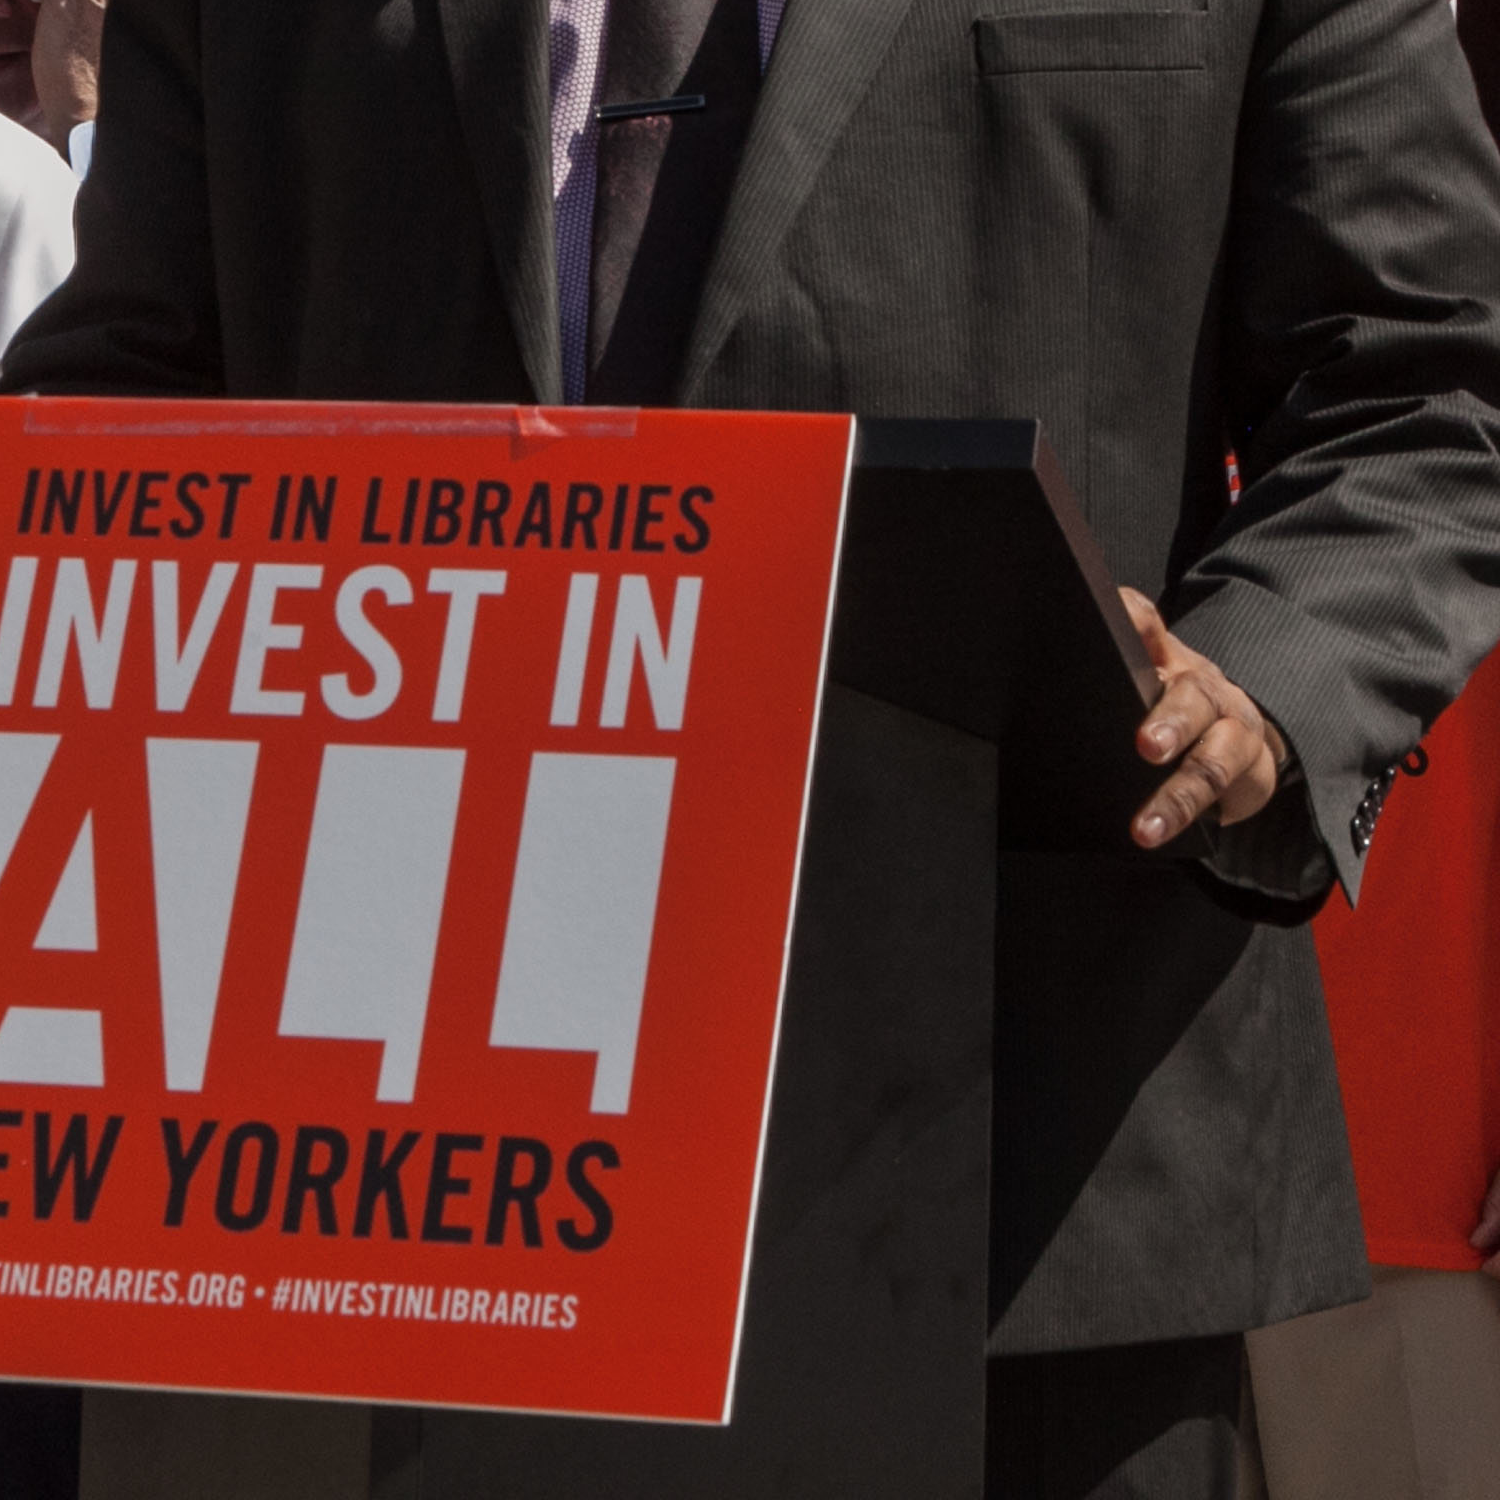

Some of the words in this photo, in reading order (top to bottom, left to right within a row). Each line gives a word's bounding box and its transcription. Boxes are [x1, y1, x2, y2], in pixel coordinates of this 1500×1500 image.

[17, 469, 250, 538] INVEST
[270, 475, 338, 543] IN
[360, 477, 716, 555] LIBRARIES
[550, 572, 703, 731] IN
[159, 1115, 622, 1253] YORKERS
[272, 1278, 579, 1329] #INVESTINLIBRARIES
